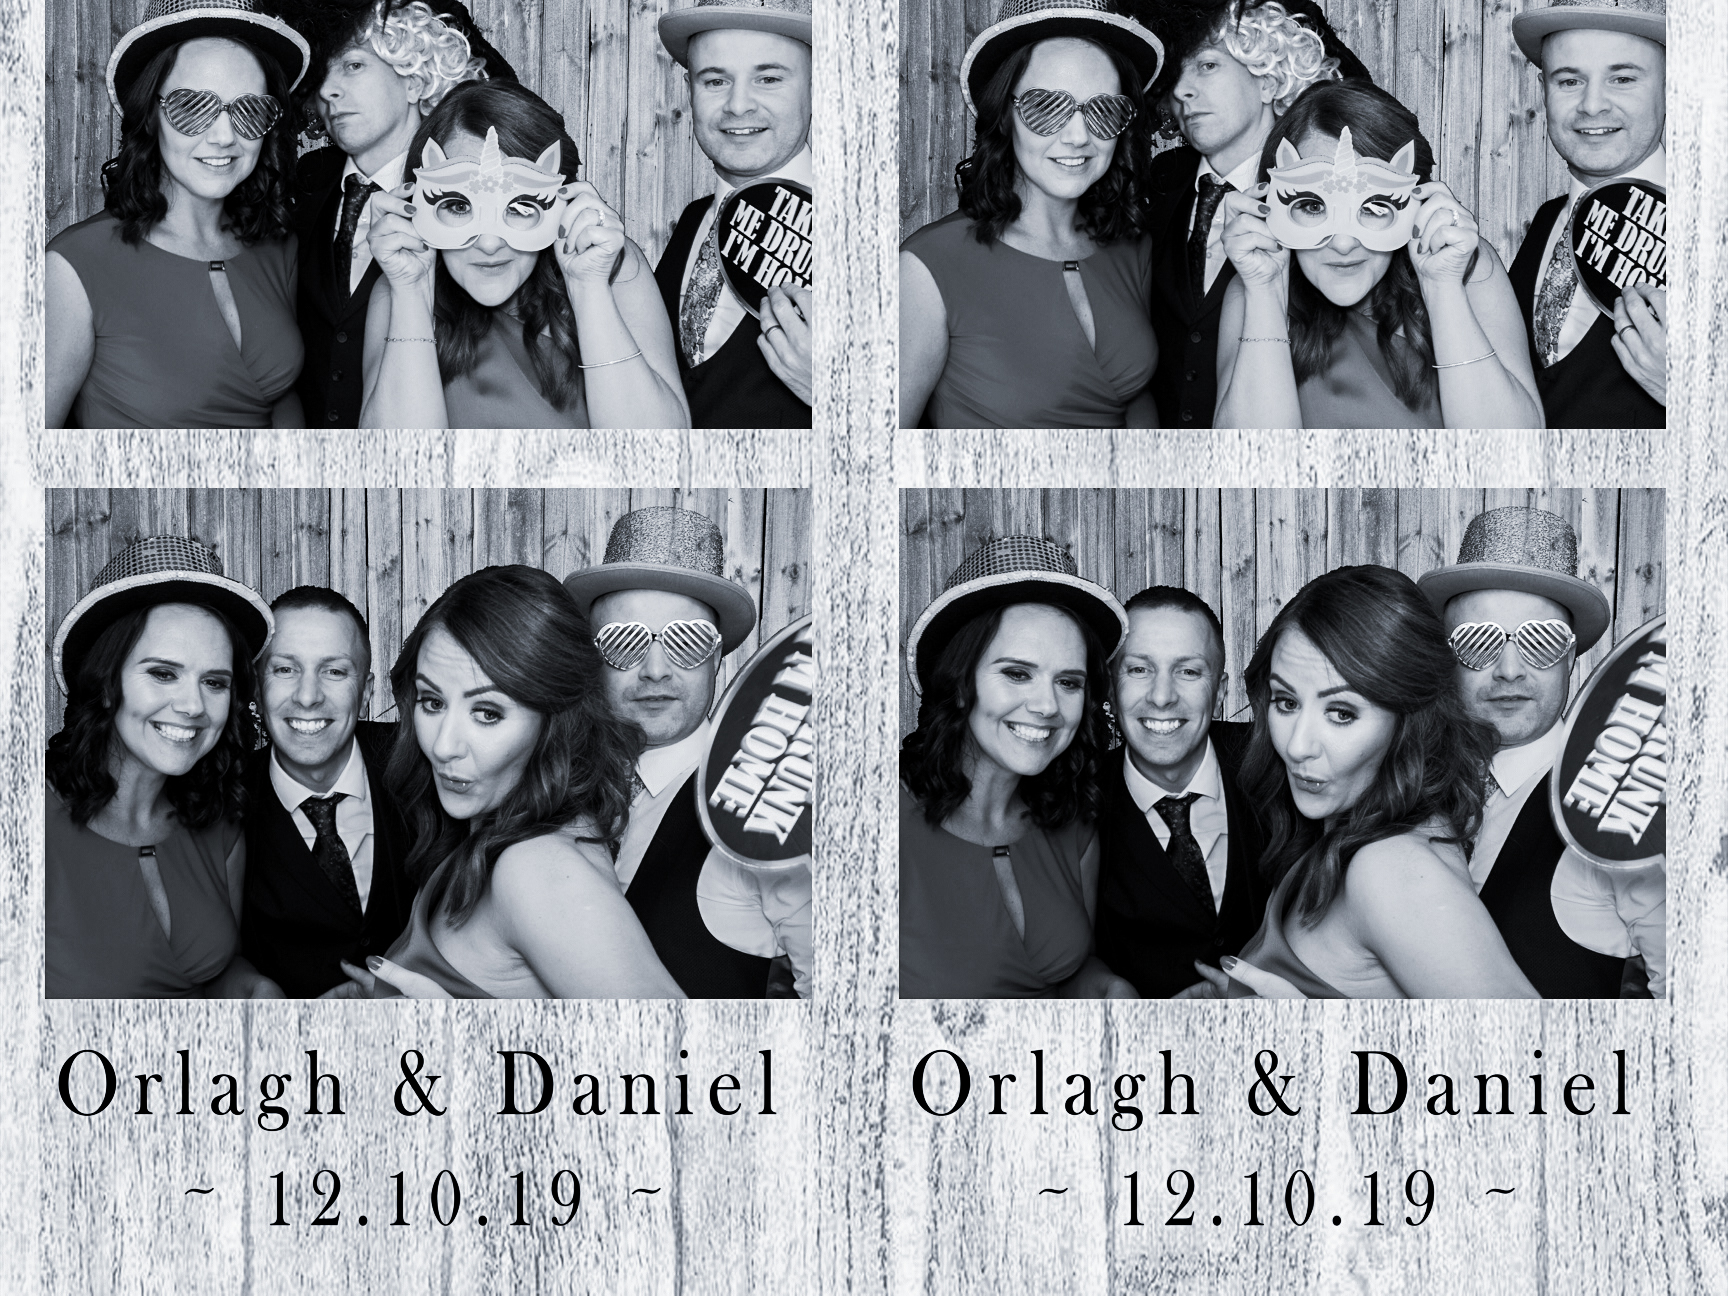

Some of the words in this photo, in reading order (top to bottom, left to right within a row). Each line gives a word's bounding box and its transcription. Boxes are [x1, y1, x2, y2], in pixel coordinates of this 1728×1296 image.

[729, 198, 765, 240] ME
[1583, 198, 1619, 240] ME
[720, 228, 759, 274] I'M
[1574, 228, 1613, 274] I'M
[708, 692, 810, 819] HOME
[1562, 692, 1664, 819] HOME
